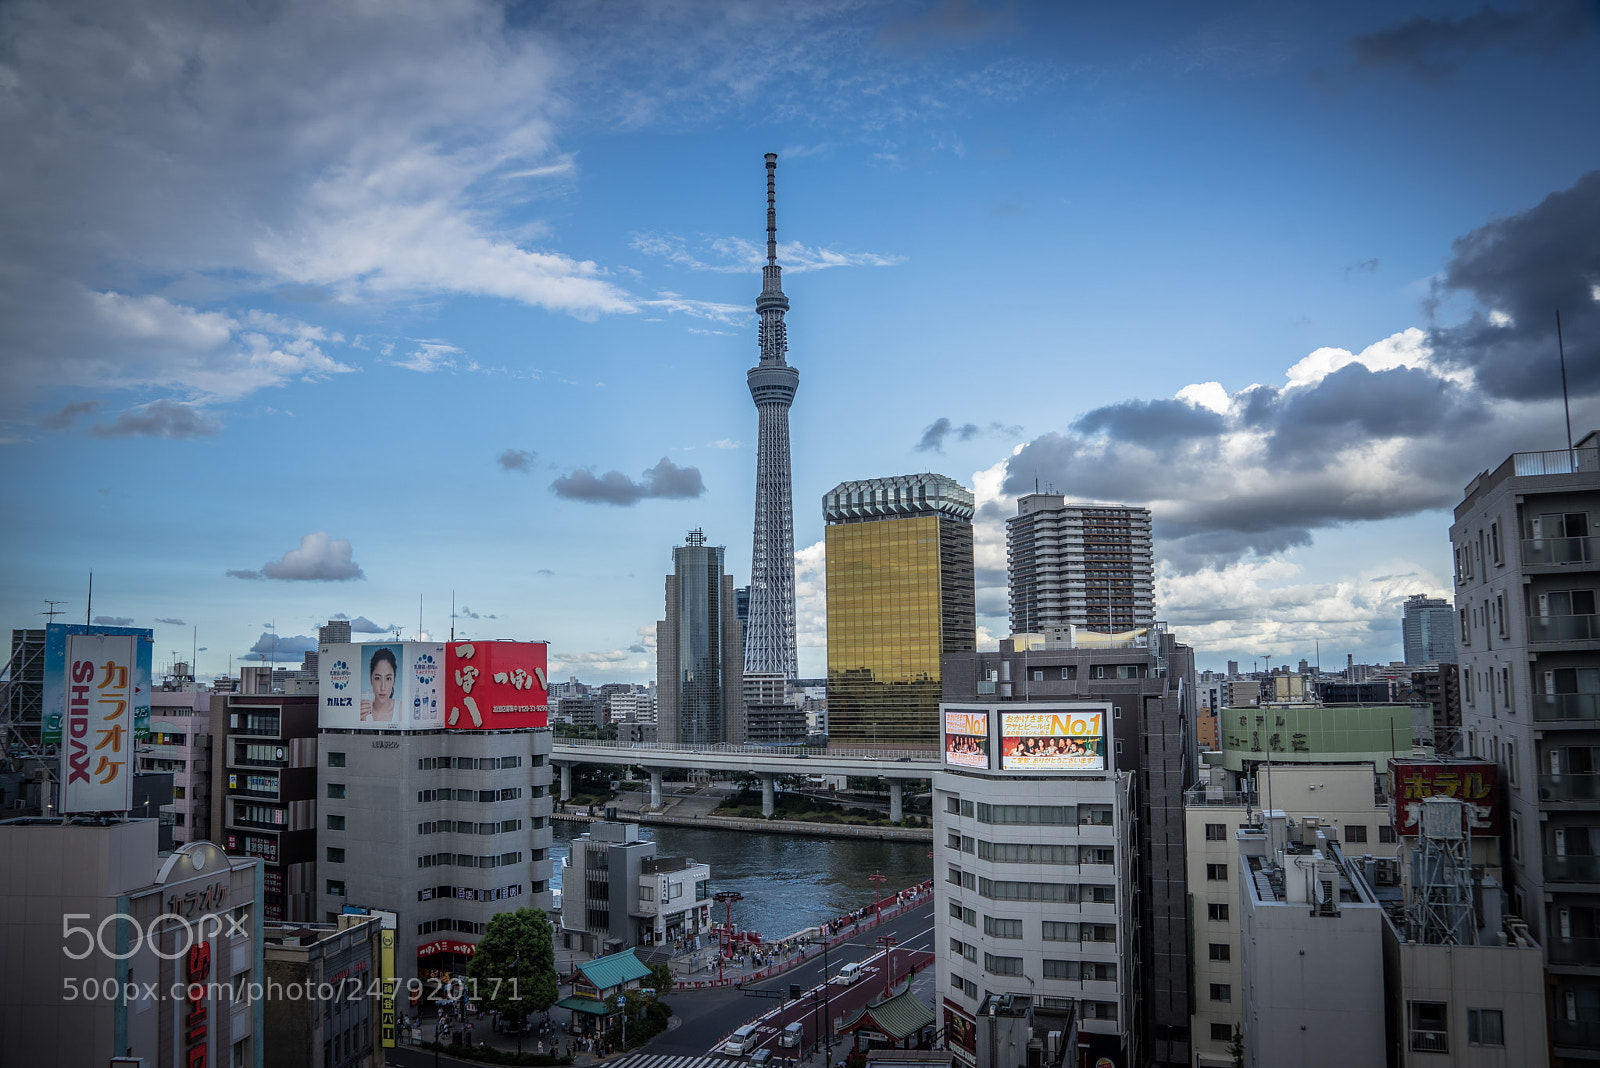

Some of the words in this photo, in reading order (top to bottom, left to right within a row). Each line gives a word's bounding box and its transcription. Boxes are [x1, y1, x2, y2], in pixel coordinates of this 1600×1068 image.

[448, 643, 483, 728] つぼ八
[493, 667, 548, 691] つぼ八
[327, 697, 353, 707] カルピス
[68, 660, 95, 786] SHIDAX
[94, 660, 128, 785] カラオケ
[965, 714, 986, 735] No.1
[1005, 714, 1052, 723] おかげさまで
[1005, 723, 1050, 731] アサヒビールは
[1050, 714, 1101, 736] No.1
[1239, 715, 1285, 727] ホテル
[1403, 772, 1493, 799] ホテル
[1403, 802, 1494, 828] カセ
[167, 882, 228, 923] カラオケ
[329, 968, 350, 985] KAMIYA
[355, 960, 367, 973] BAR
[383, 982, 394, 1040] 神谷バー
